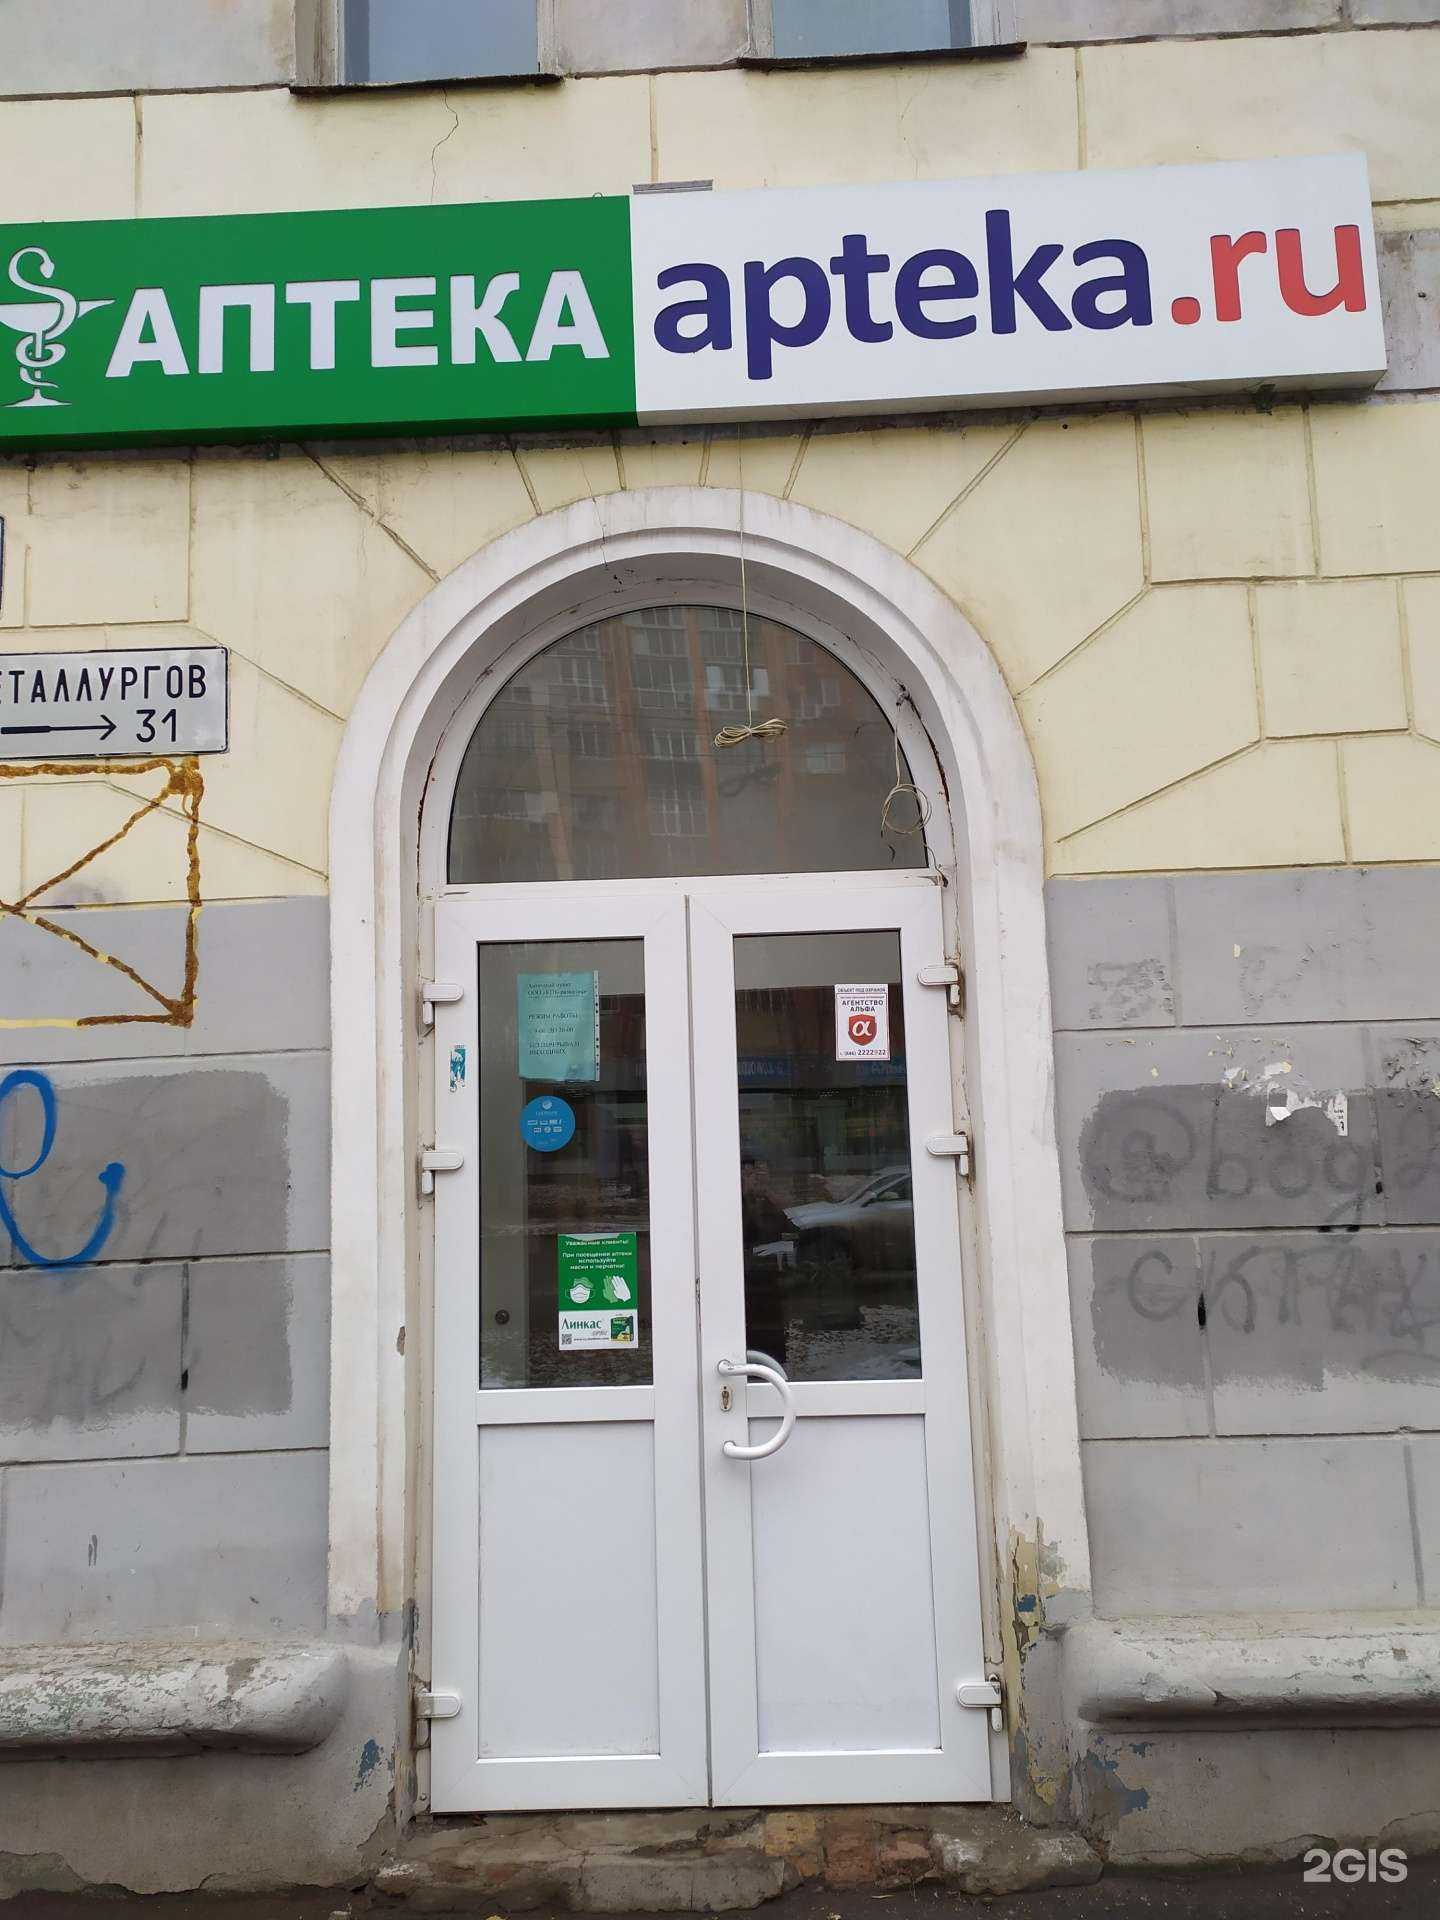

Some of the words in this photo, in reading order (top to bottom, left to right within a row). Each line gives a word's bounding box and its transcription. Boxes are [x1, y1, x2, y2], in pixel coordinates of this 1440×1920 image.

[653, 209, 1367, 381] apteka.ru
[105, 270, 610, 378] АПТЕКА
[0, 665, 207, 704] ТАЛЛУРГОВ
[136, 708, 177, 743] 31
[561, 1318, 602, 1330] Линкас
